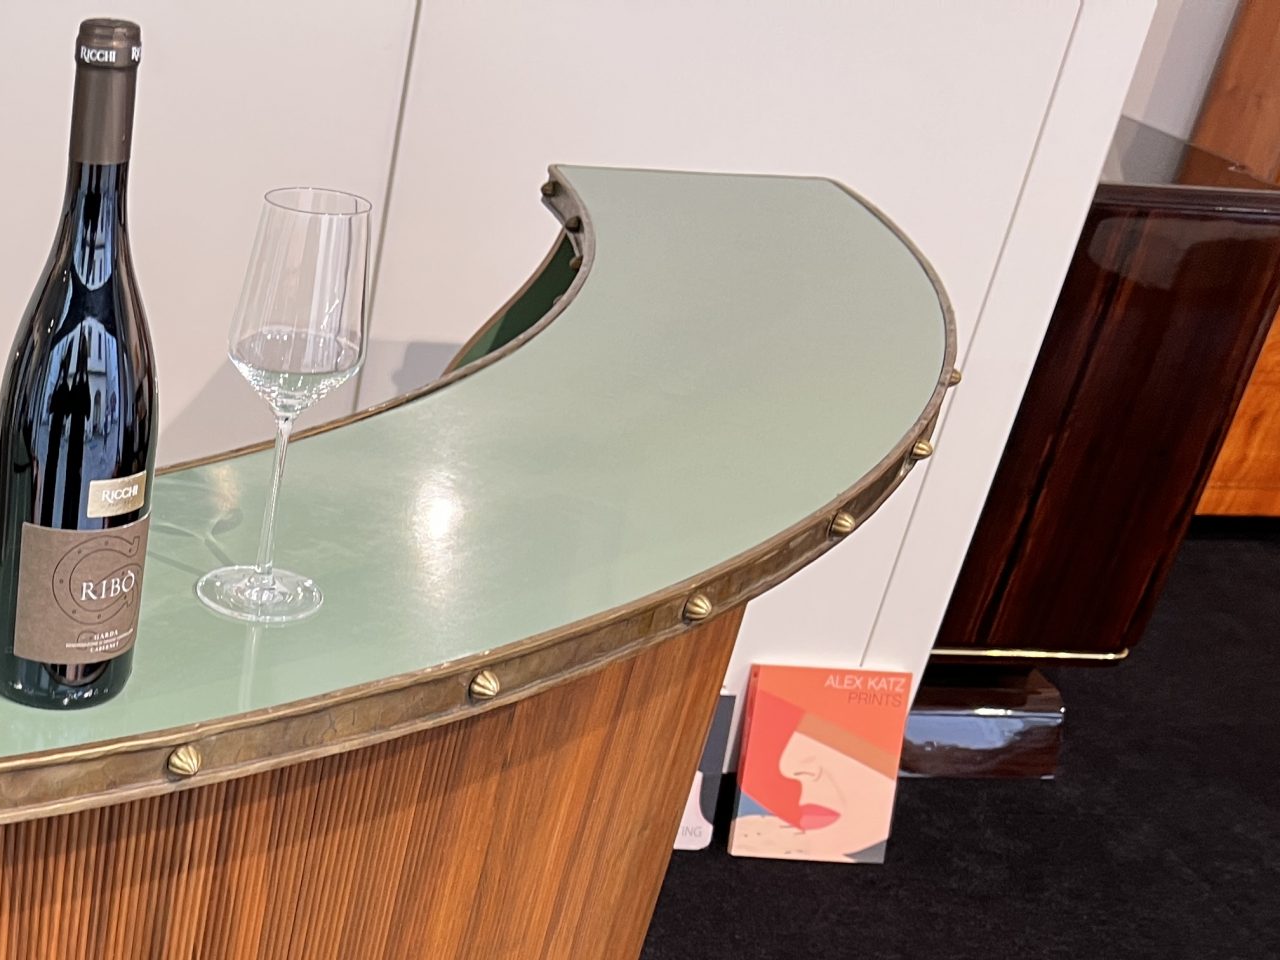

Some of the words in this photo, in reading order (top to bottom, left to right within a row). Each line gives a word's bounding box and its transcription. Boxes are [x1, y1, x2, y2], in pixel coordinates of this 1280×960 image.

[80, 46, 116, 64] RICCHI
[102, 484, 139, 504] RICCHI
[81, 570, 135, 600] RIBÒ
[824, 674, 864, 690] ALEX
[867, 676, 905, 692] KATZ
[847, 691, 902, 708] PRINTS
